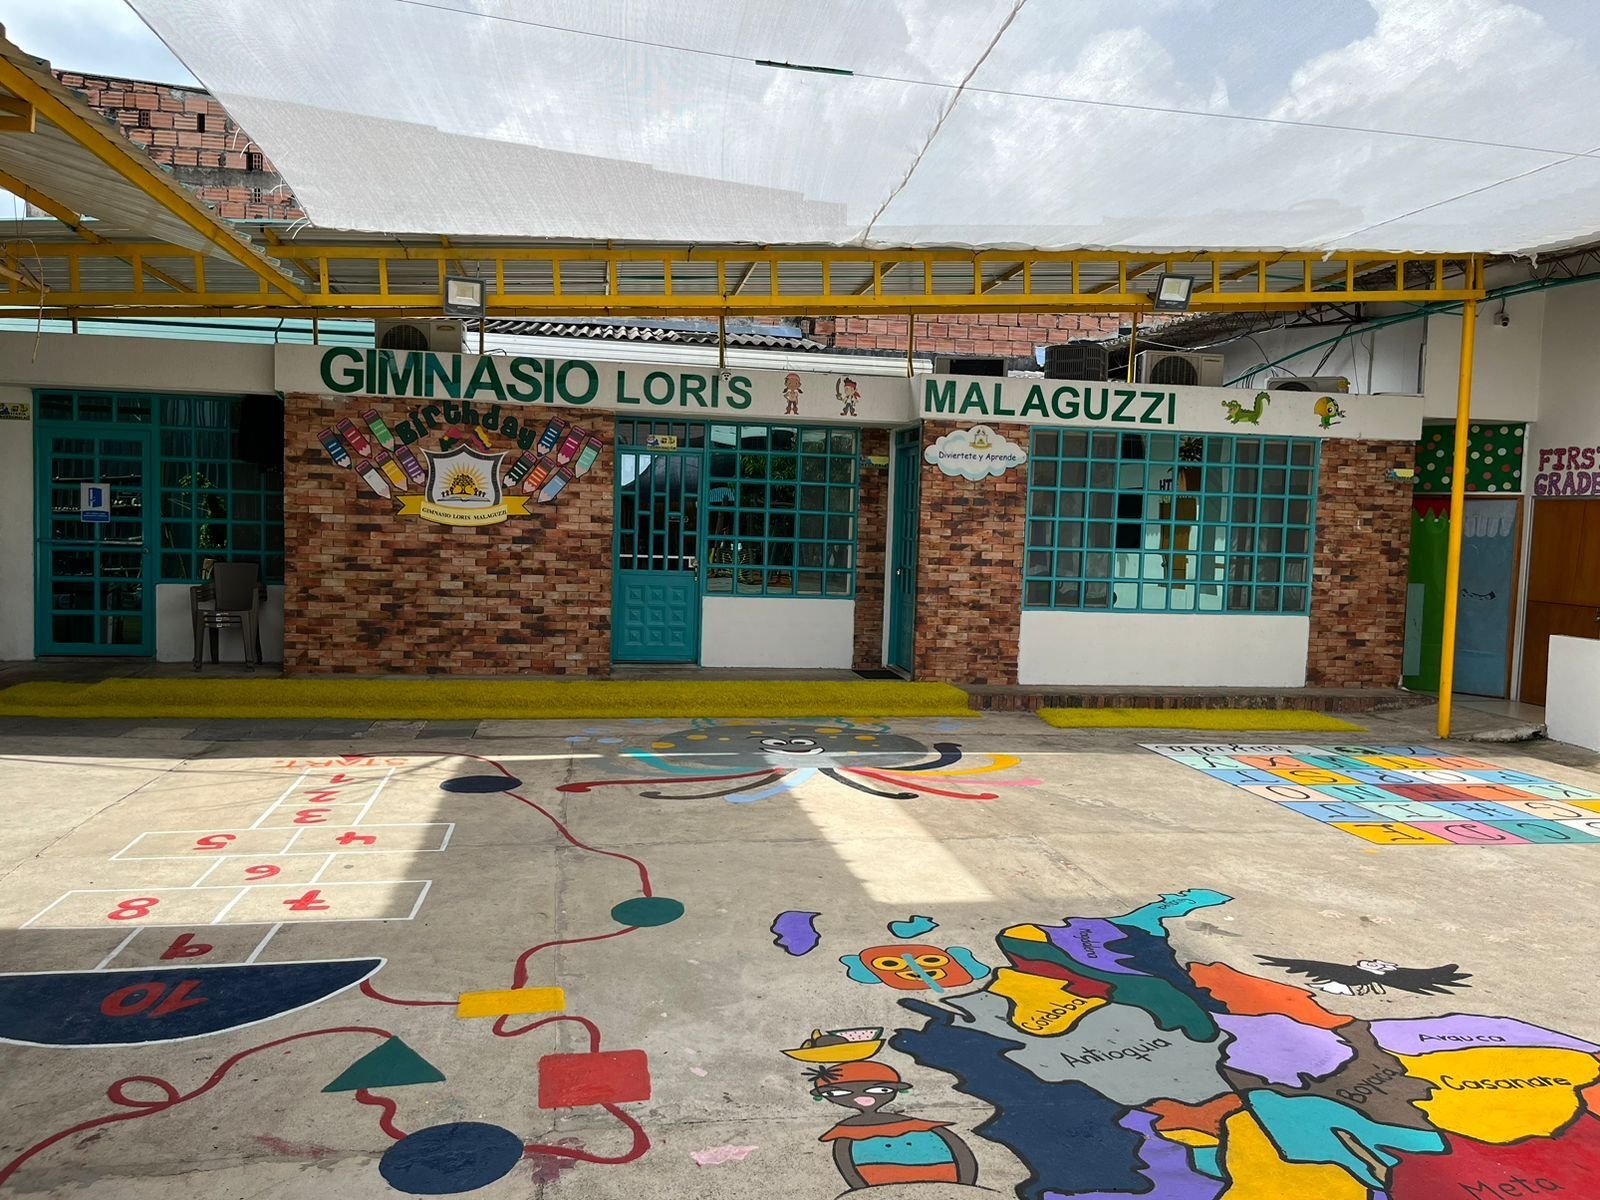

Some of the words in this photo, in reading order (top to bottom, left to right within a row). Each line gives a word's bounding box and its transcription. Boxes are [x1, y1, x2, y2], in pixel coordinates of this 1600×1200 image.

[320, 346, 599, 404] GIMNASIO
[617, 370, 752, 410] LORIS
[924, 379, 1176, 424] MALAGUZZI
[395, 400, 537, 450] Birthday
[938, 451, 977, 460] Diviertete
[985, 453, 1016, 462] Aprende
[1534, 471, 1600, 496] GRADE
[421, 507, 451, 518] GIMNASIO
[271, 757, 409, 768] START
[1290, 770, 1338, 783] S
[303, 790, 341, 803] 2
[1266, 785, 1310, 799] O
[293, 808, 332, 824] 3
[335, 832, 377, 845] 4
[1517, 823, 1571, 840] C
[193, 833, 236, 850] 5
[244, 865, 280, 881] 6
[107, 897, 160, 920] 8
[282, 890, 330, 911] 7
[160, 932, 213, 960] 9
[100, 979, 208, 1019] 10
[1021, 996, 1088, 1032] Córdoba
[1418, 1033, 1506, 1043] Arauca
[1060, 1036, 1172, 1068] Antioquia
[1335, 1062, 1400, 1104] Boyacá
[1439, 1074, 1572, 1091] Casanare
[1458, 1172, 1566, 1200] Meta
